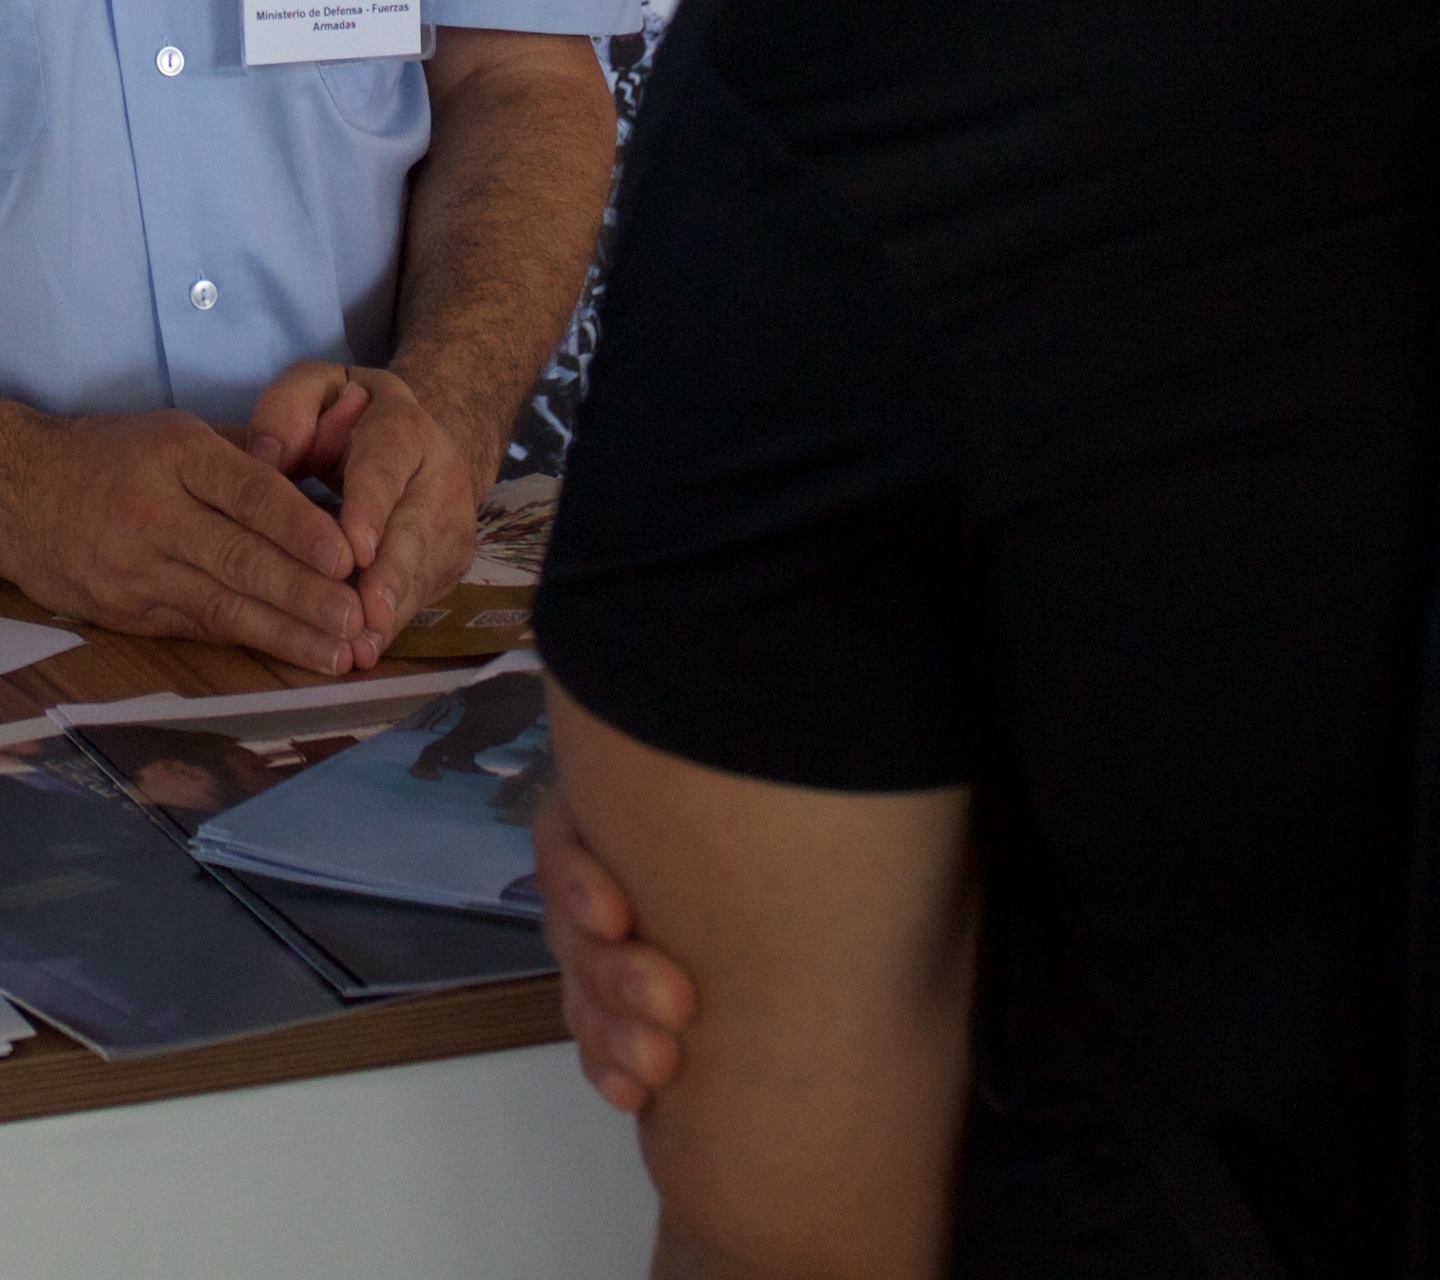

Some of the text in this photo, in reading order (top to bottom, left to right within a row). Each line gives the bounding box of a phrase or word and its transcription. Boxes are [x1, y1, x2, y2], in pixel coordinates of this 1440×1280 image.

[256, 10, 306, 21] Ministerio
[309, 8, 321, 18] de
[323, 6, 363, 17] Defensa
[372, 2, 410, 14] Fuerzas
[313, 22, 357, 32] Armadas
